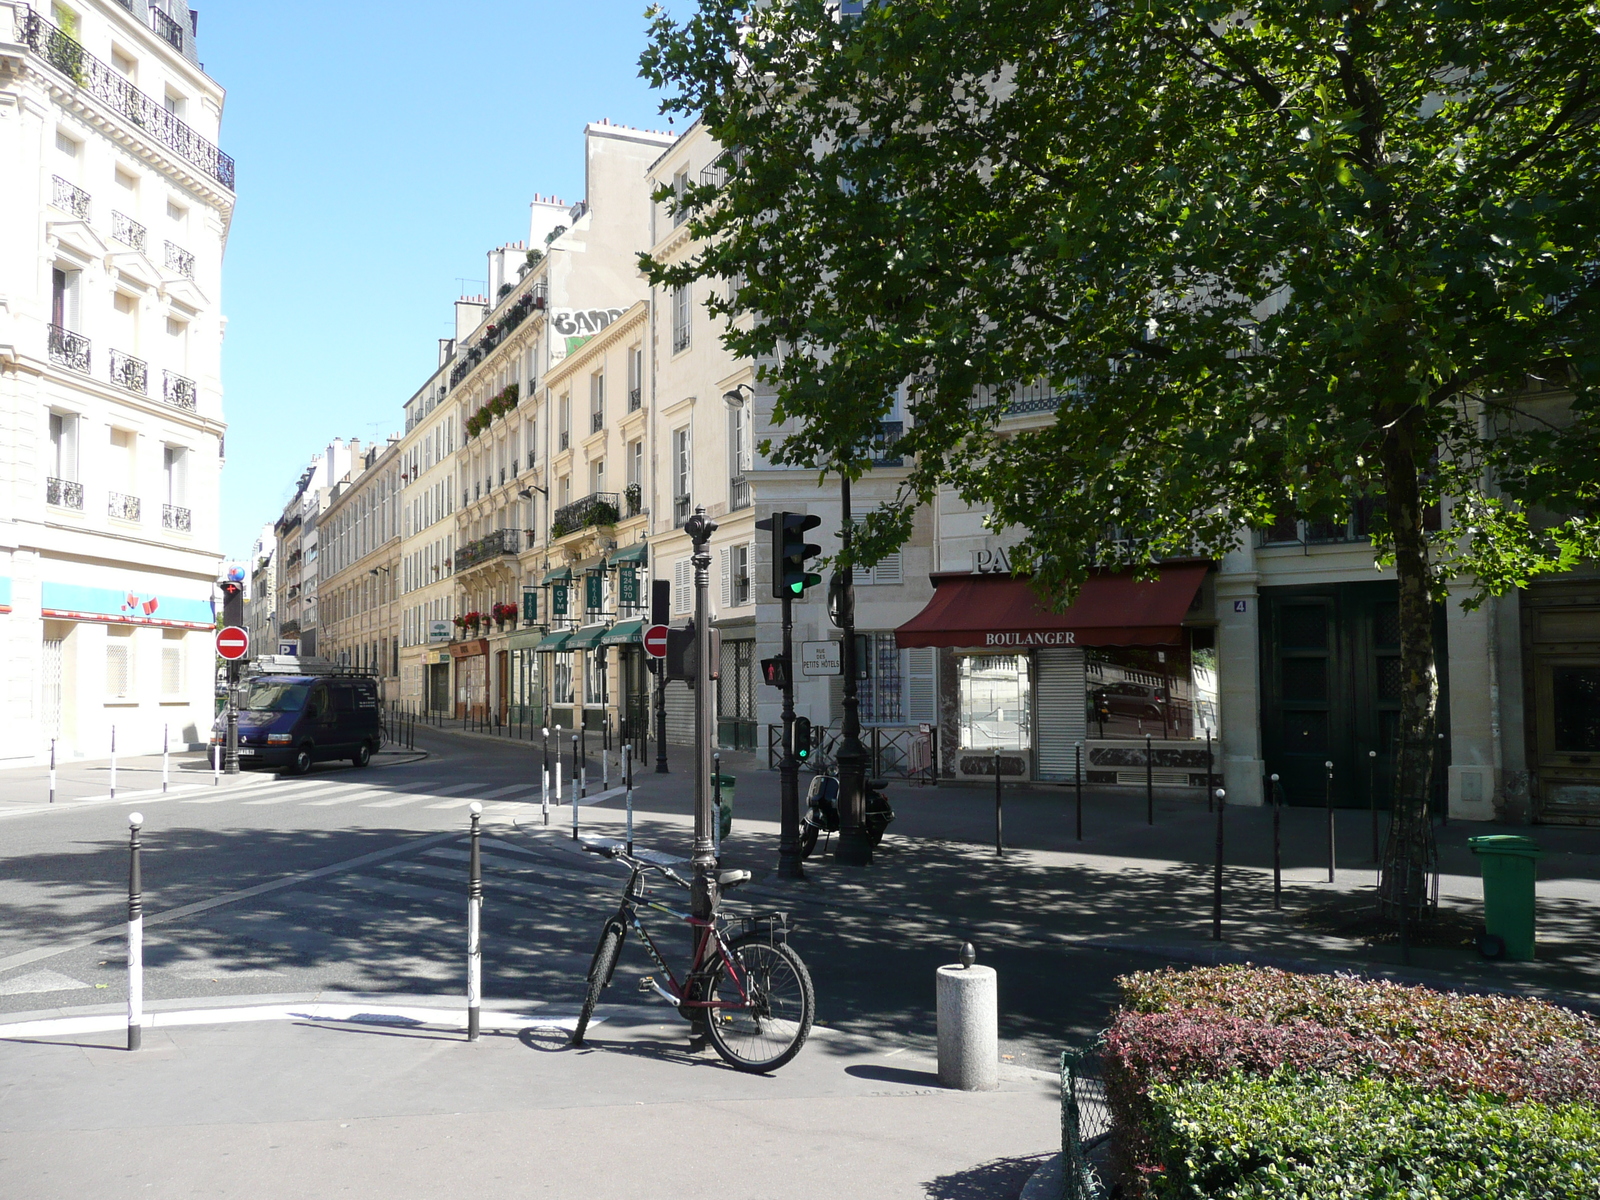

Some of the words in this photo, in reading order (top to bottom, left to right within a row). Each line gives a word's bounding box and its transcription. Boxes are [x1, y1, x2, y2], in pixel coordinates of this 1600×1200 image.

[556, 591, 565, 610] GYM
[1236, 601, 1245, 611] 4
[985, 632, 1076, 645] BOULANGER
[281, 646, 291, 655] P
[803, 660, 819, 668] PETITS
[821, 659, 840, 668] HÔTELS
